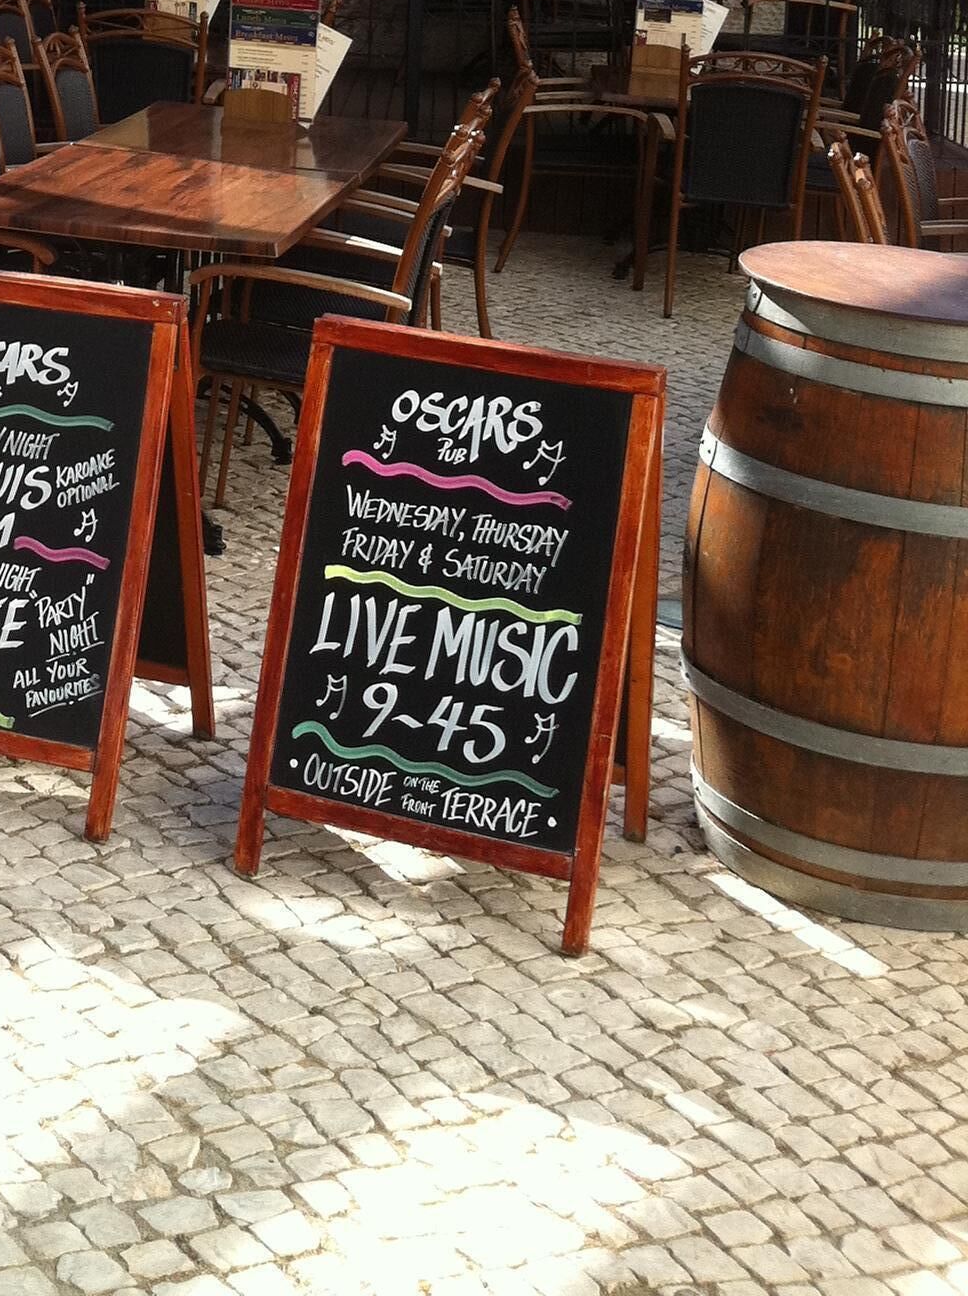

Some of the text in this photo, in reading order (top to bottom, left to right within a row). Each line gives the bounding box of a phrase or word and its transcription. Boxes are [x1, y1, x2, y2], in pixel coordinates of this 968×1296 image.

[5, 429, 60, 461] NIGHT
[391, 389, 543, 463] OSCARS
[55, 448, 117, 489] KAROAKE
[437, 437, 468, 465] PUB
[57, 472, 121, 509] OPTIONAL
[341, 527, 548, 594] FRIDAY & SATURDAY
[472, 513, 569, 567] THURSDAY
[49, 611, 101, 656] NIGHT
[309, 592, 579, 704] LIVE MUSIC
[12, 657, 91, 690] ALL YOUR
[25, 673, 101, 709] FAVOURITES
[303, 753, 398, 807] OUTSIDE
[419, 776, 441, 794] THE
[440, 786, 542, 838] TERRACE
[401, 795, 436, 818] FRONT
